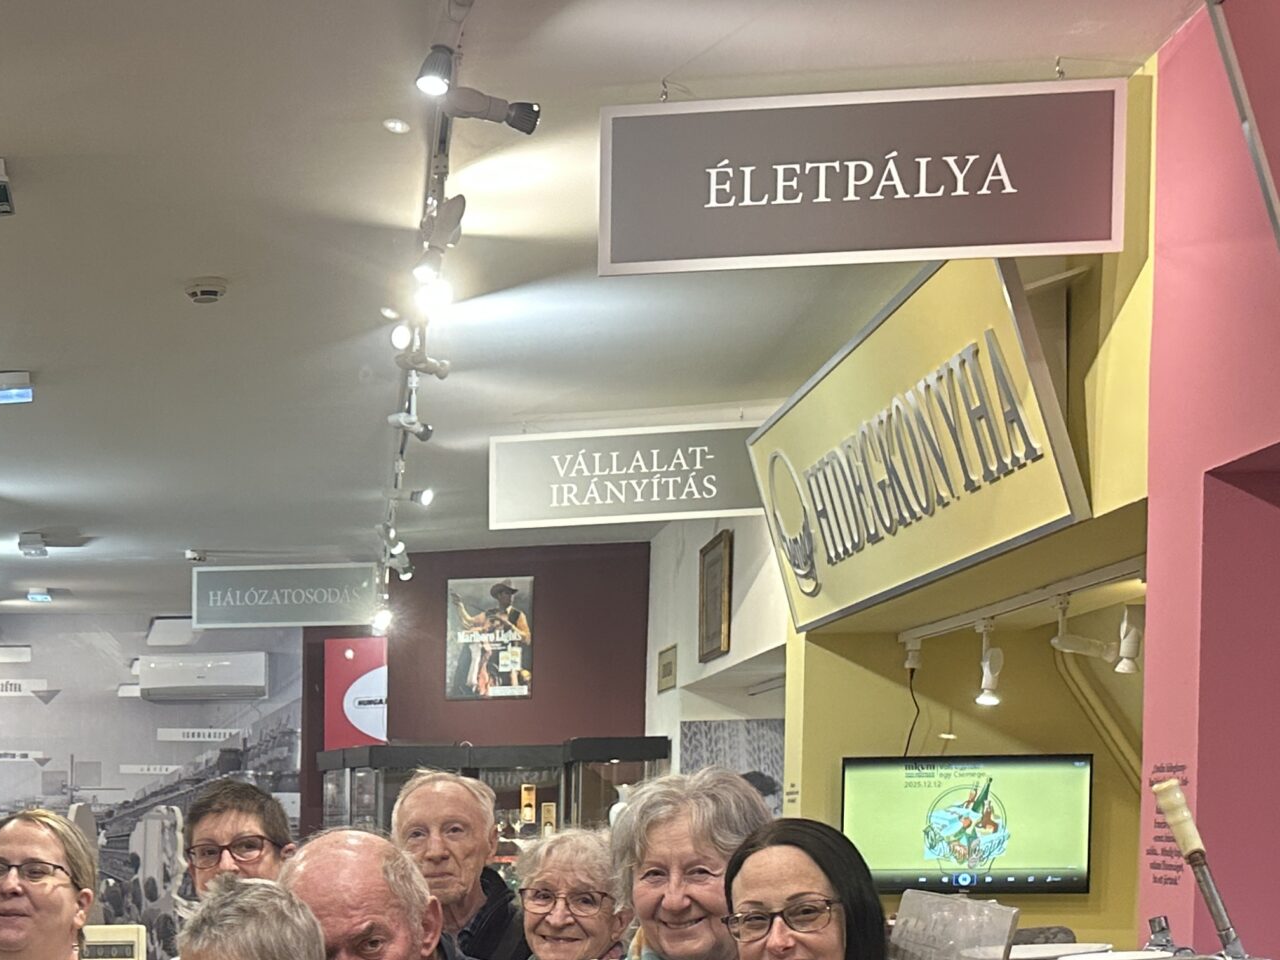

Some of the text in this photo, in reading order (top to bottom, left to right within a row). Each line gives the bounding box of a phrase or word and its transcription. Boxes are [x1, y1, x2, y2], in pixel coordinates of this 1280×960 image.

[704, 151, 1018, 211] ÉLETPÁLYA
[551, 446, 715, 477] VÁLLALAT-
[803, 328, 1045, 567] HIDEGKONYHA
[549, 472, 718, 508] IRÁNYÍTÁS
[208, 586, 361, 607] HÁLÓZATOSODÁS
